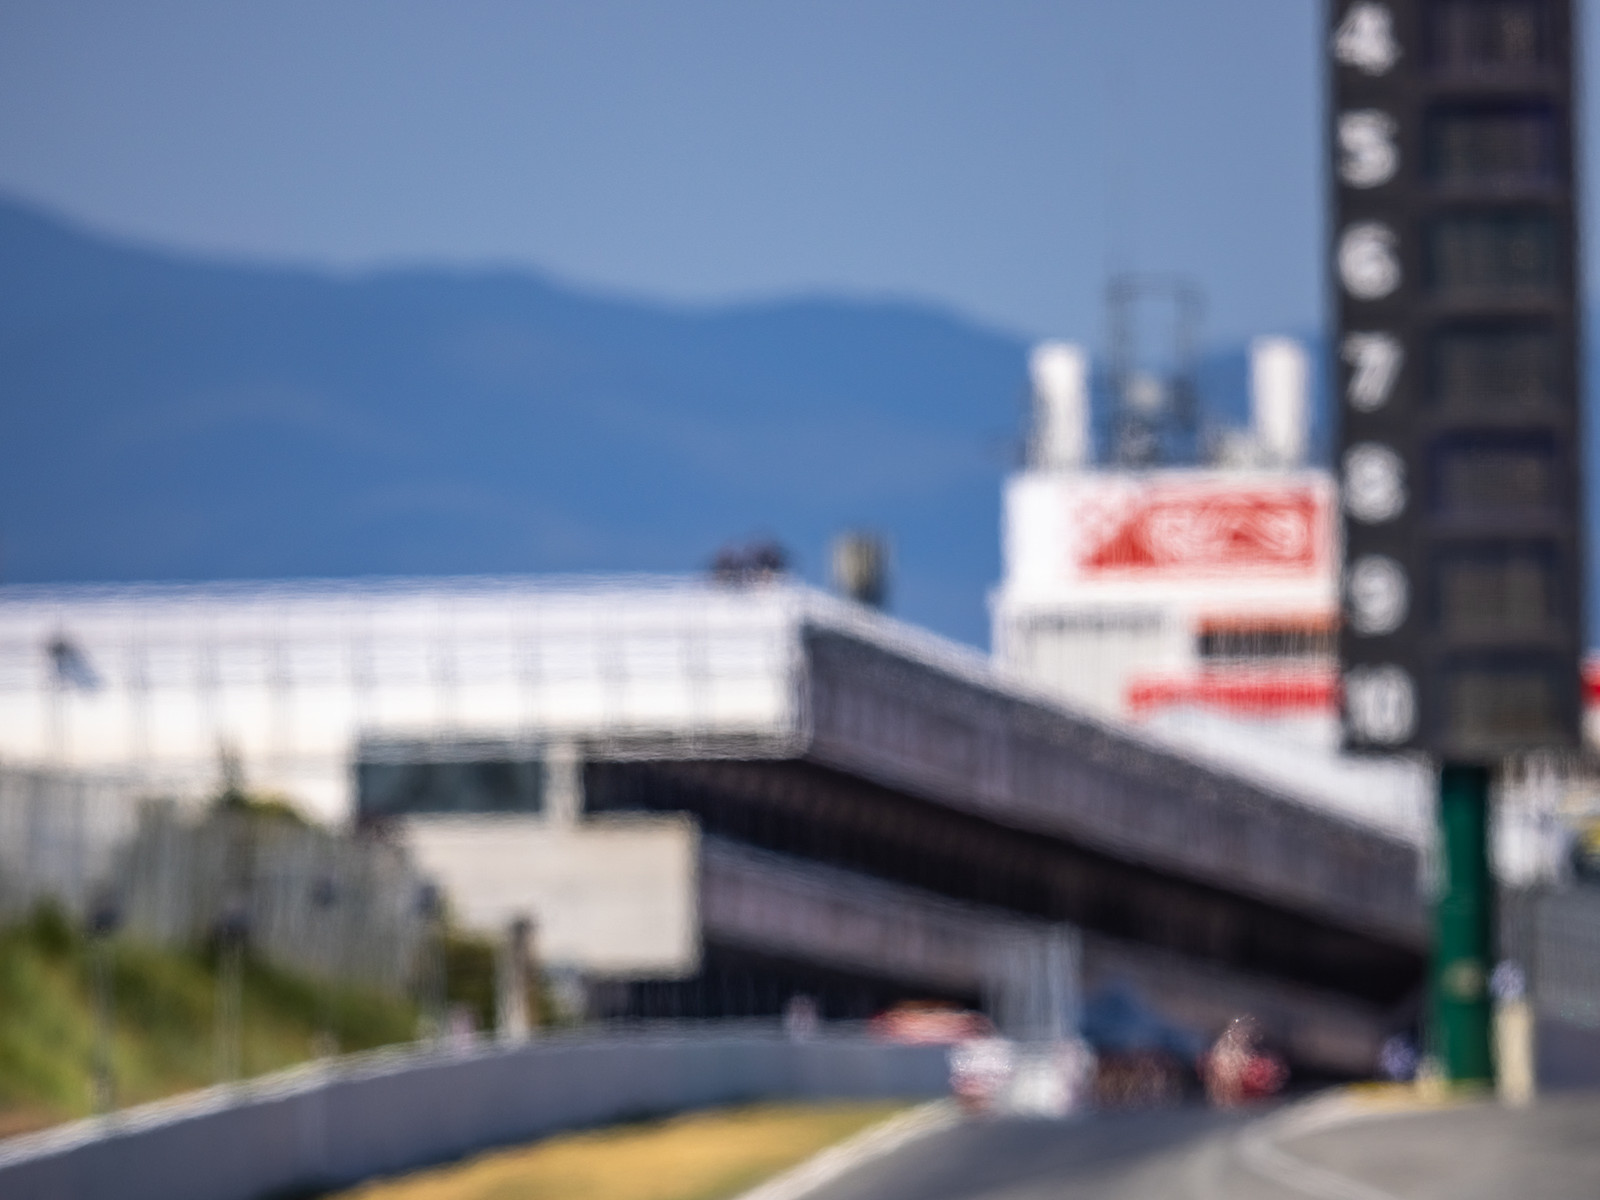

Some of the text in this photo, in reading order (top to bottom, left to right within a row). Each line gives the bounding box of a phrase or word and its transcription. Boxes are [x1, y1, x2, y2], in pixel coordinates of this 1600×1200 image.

[1335, 1, 1401, 73] 4
[1337, 108, 1399, 187] 5
[1338, 222, 1401, 300] 6
[1342, 332, 1404, 412] 7
[1343, 444, 1408, 523] 8
[1347, 554, 1409, 634] 9
[1346, 665, 1417, 745] 10
